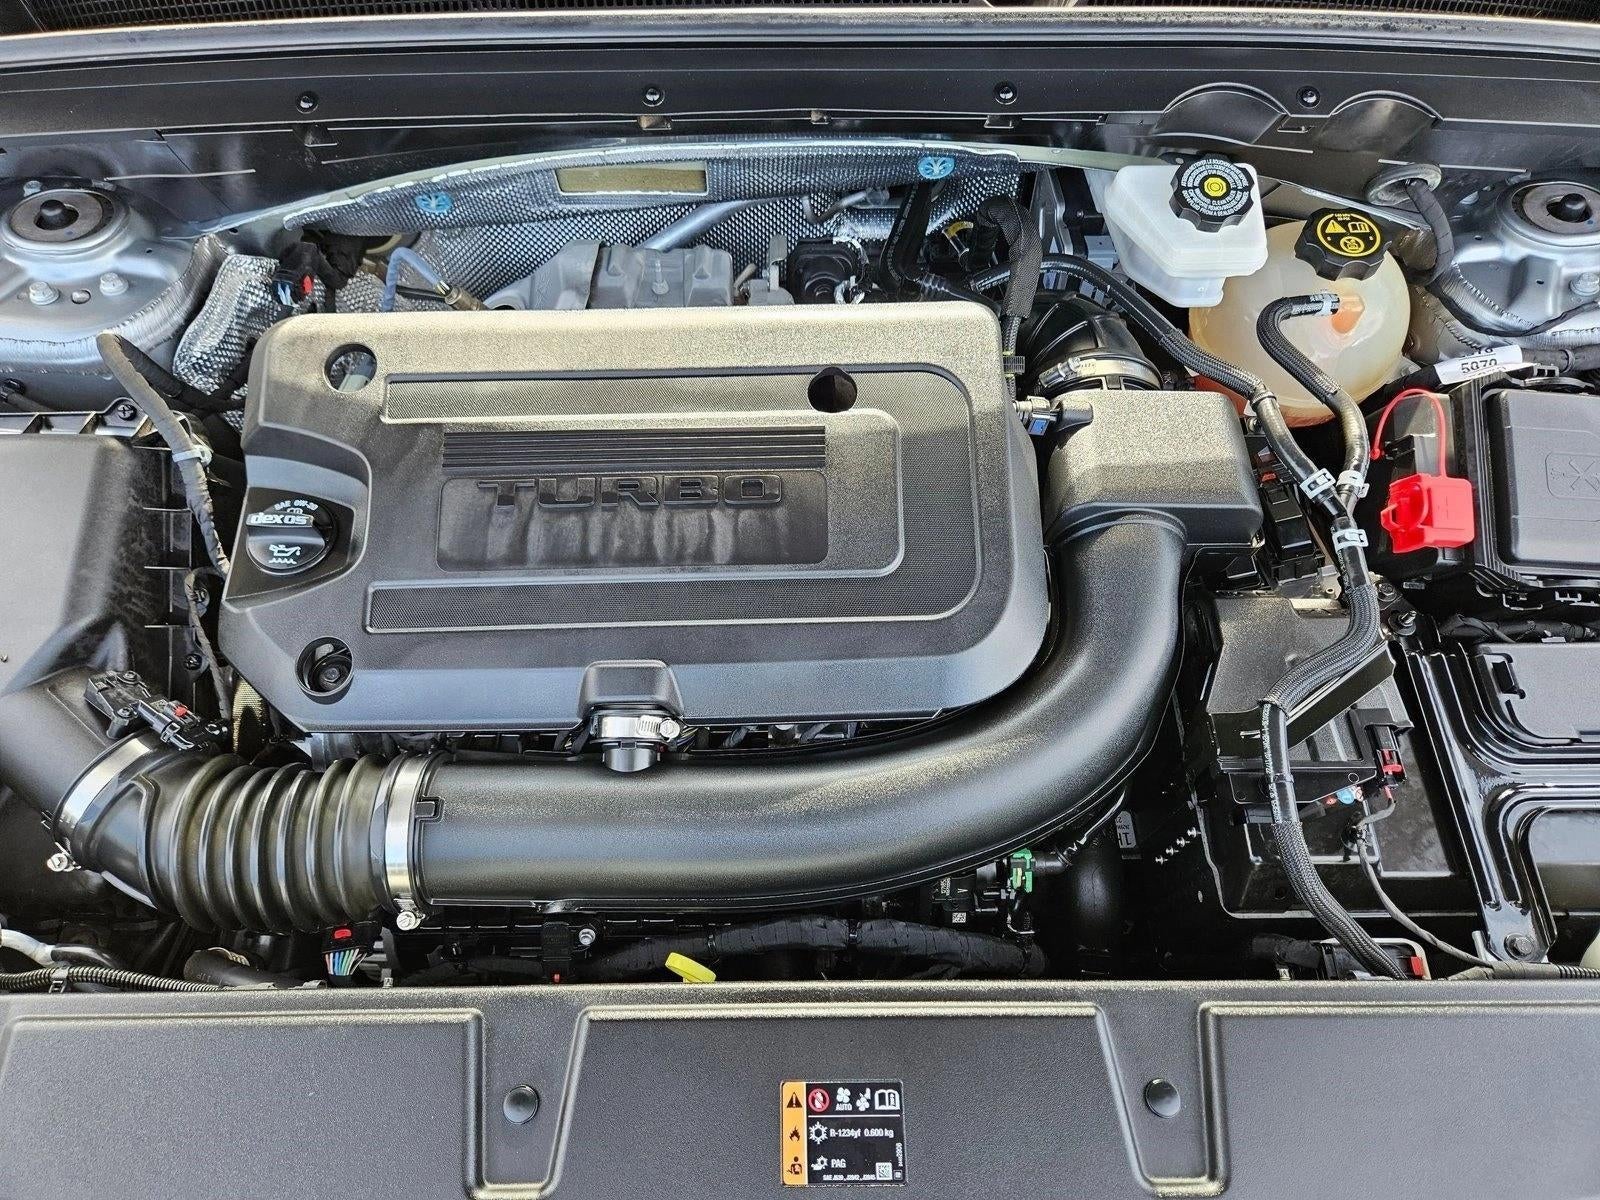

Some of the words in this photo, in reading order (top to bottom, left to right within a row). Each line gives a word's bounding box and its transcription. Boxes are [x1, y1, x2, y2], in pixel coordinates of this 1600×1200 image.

[477, 474, 782, 509] TURBO
[250, 512, 307, 525] dexos
[835, 1103, 852, 1111] AUTO
[829, 1128, 861, 1139] R-1234yf
[863, 1128, 884, 1137] 0.600
[884, 1128, 895, 1139] kg
[830, 1158, 847, 1168] PAG
